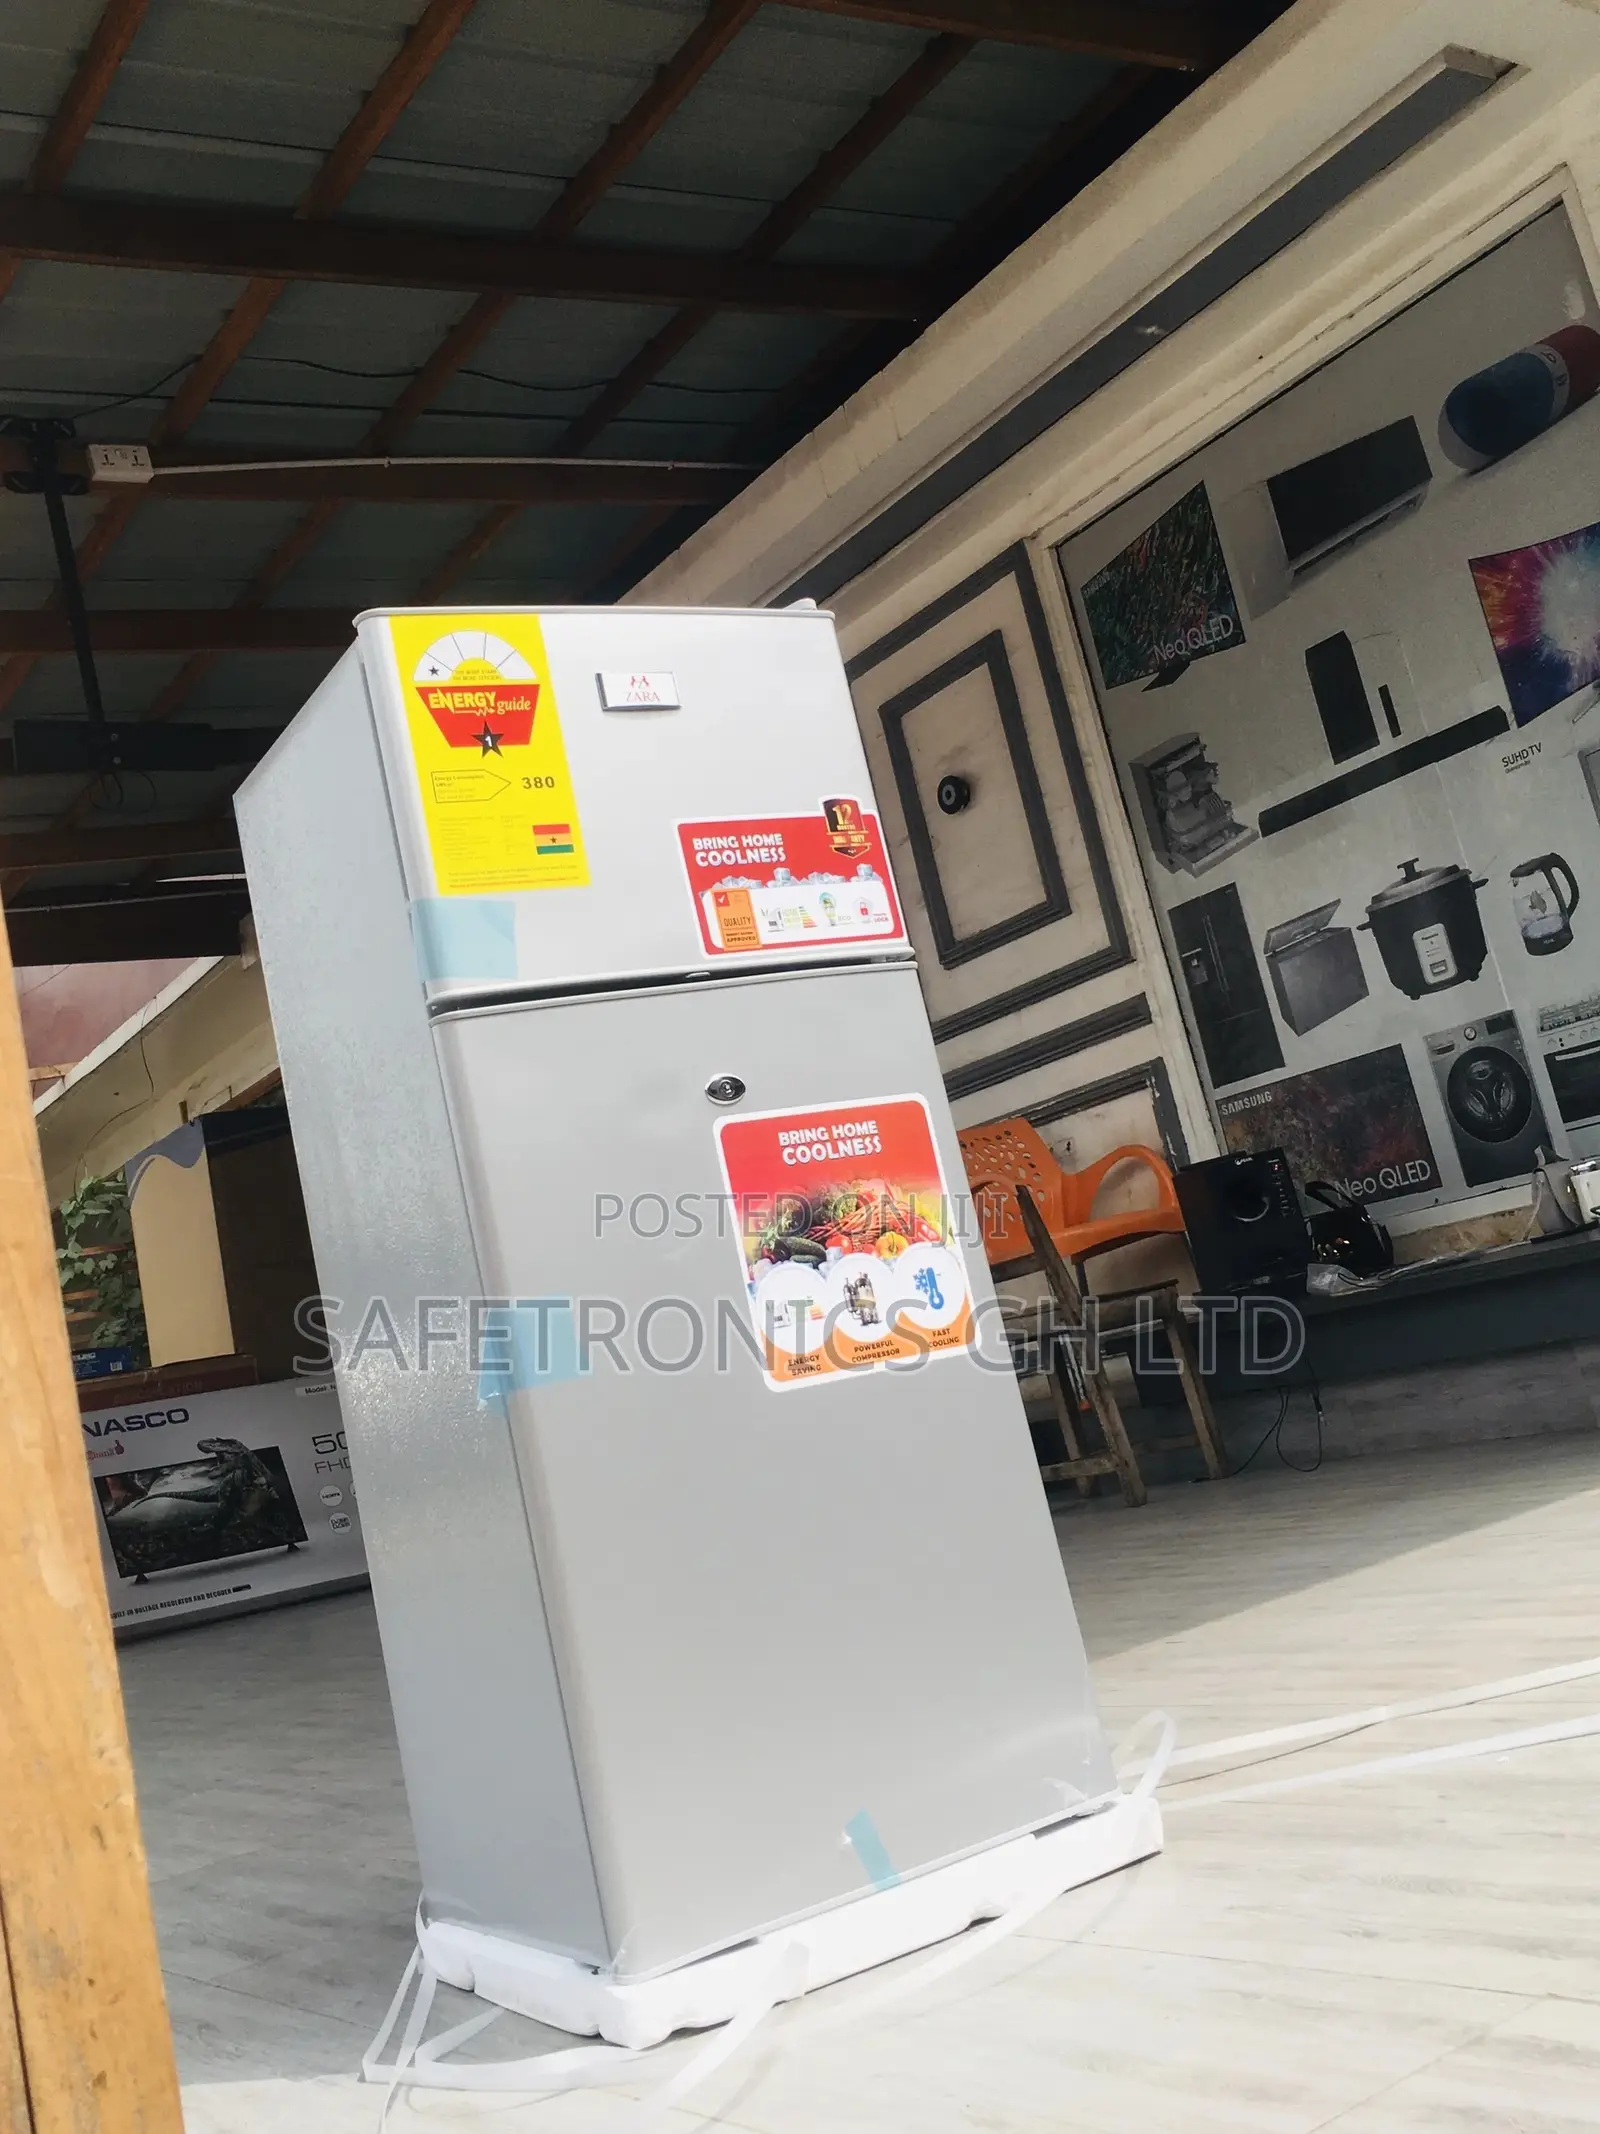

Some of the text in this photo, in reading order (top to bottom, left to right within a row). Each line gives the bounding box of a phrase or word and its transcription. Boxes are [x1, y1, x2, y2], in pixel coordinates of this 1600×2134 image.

[1187, 614, 1233, 649] QLED
[428, 687, 531, 715] ENERGY guide
[484, 735, 492, 747] 1
[1501, 741, 1542, 767] SUHD TV
[521, 775, 555, 790] 380
[832, 803, 852, 825] 12
[692, 833, 784, 851] BRING HOME
[695, 846, 786, 867] COOLNESS
[723, 916, 751, 927] QUALITY
[1221, 1091, 1273, 1116] SAMSUNG
[778, 1119, 879, 1147] BRING HOME
[782, 1135, 882, 1166] COOLNESS
[1335, 1159, 1431, 1200] Neo QLED
[928, 1336, 960, 1348] COOLING
[932, 1328, 951, 1338] FAST
[851, 1347, 900, 1363] COMPRESSOR
[854, 1340, 895, 1352] POWERFUL
[788, 1354, 820, 1366] ENERGY
[791, 1364, 822, 1376] SAVING
[82, 1408, 190, 1437] NASCO
[134, 1603, 159, 1615] VOLTAGE
[160, 1597, 193, 1609] REGULATOR
[193, 1593, 206, 1602] AND
[206, 1588, 232, 1599] DECODER
